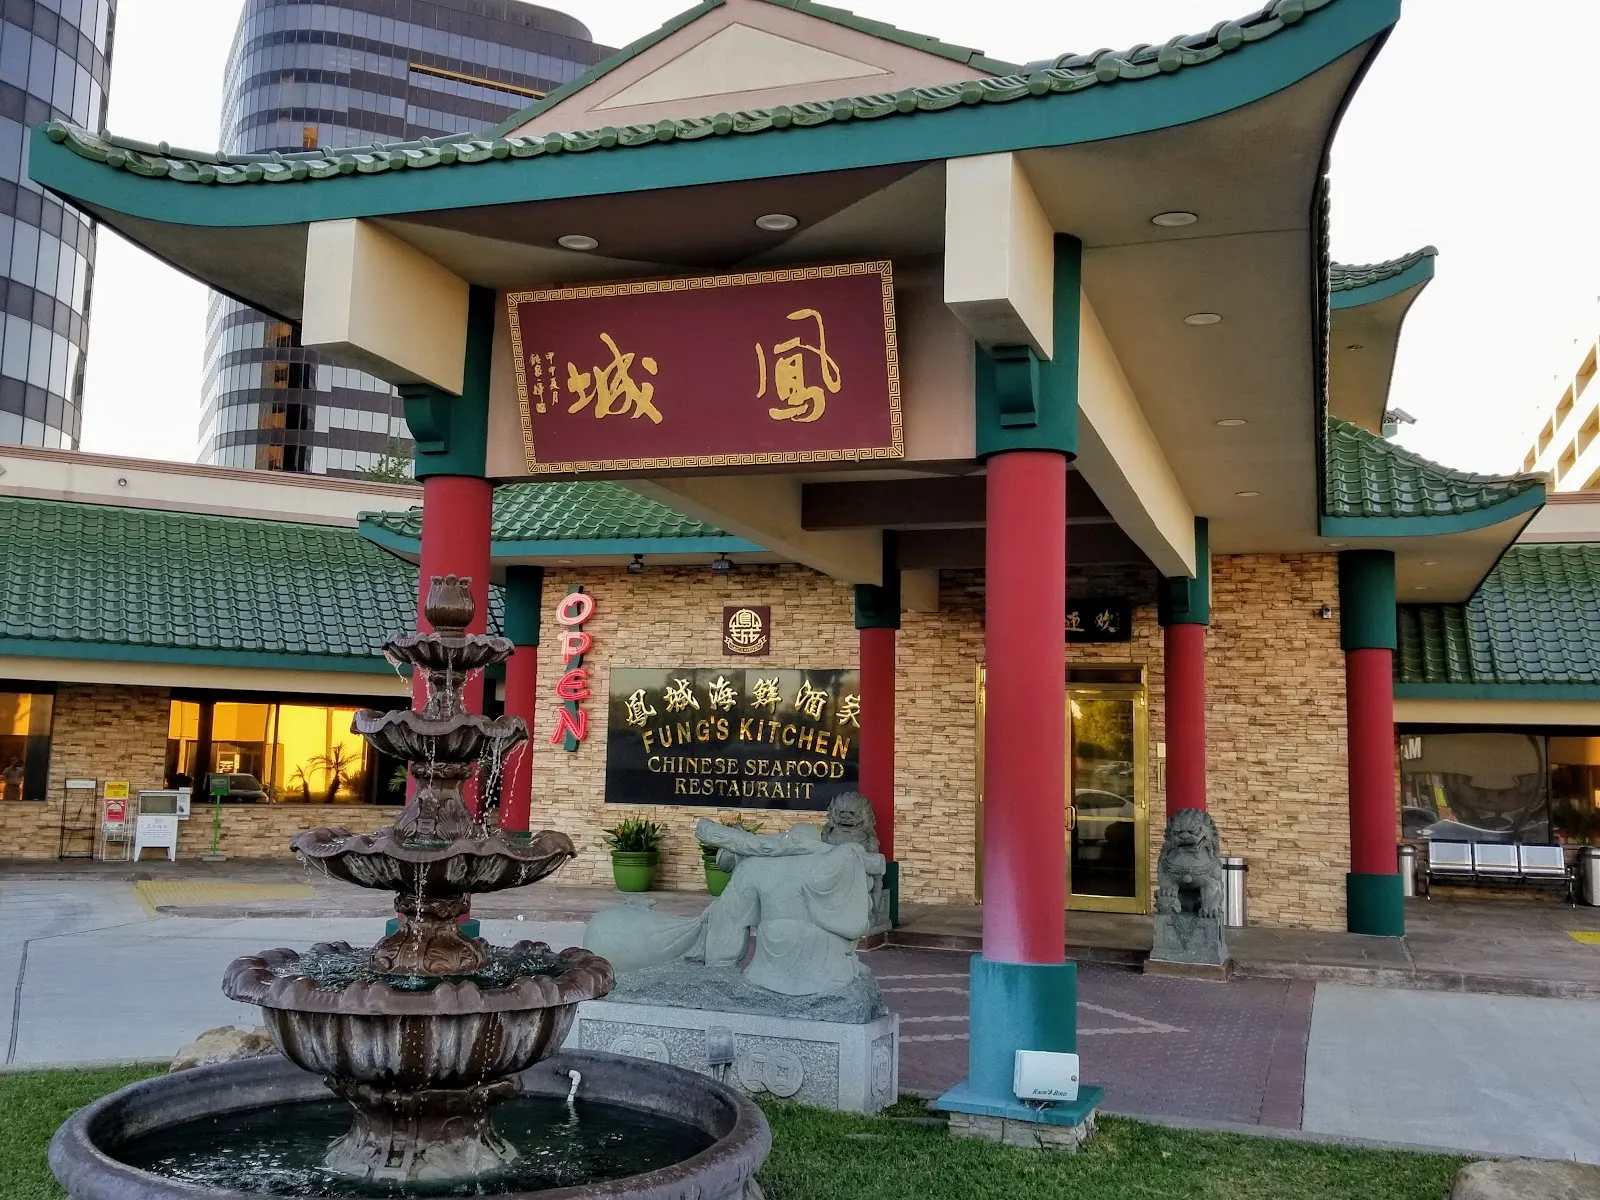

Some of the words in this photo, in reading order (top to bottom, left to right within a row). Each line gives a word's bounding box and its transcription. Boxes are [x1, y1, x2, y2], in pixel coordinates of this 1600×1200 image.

[550, 592, 596, 745] OPEN
[641, 716, 730, 754] FUNG'S
[739, 717, 851, 760] KITCHEN
[647, 756, 739, 775] CHINESE
[744, 759, 845, 779] SEAFOOD
[674, 777, 816, 800] RESTAURANT
[1052, 1089, 1068, 1097] BIRD
